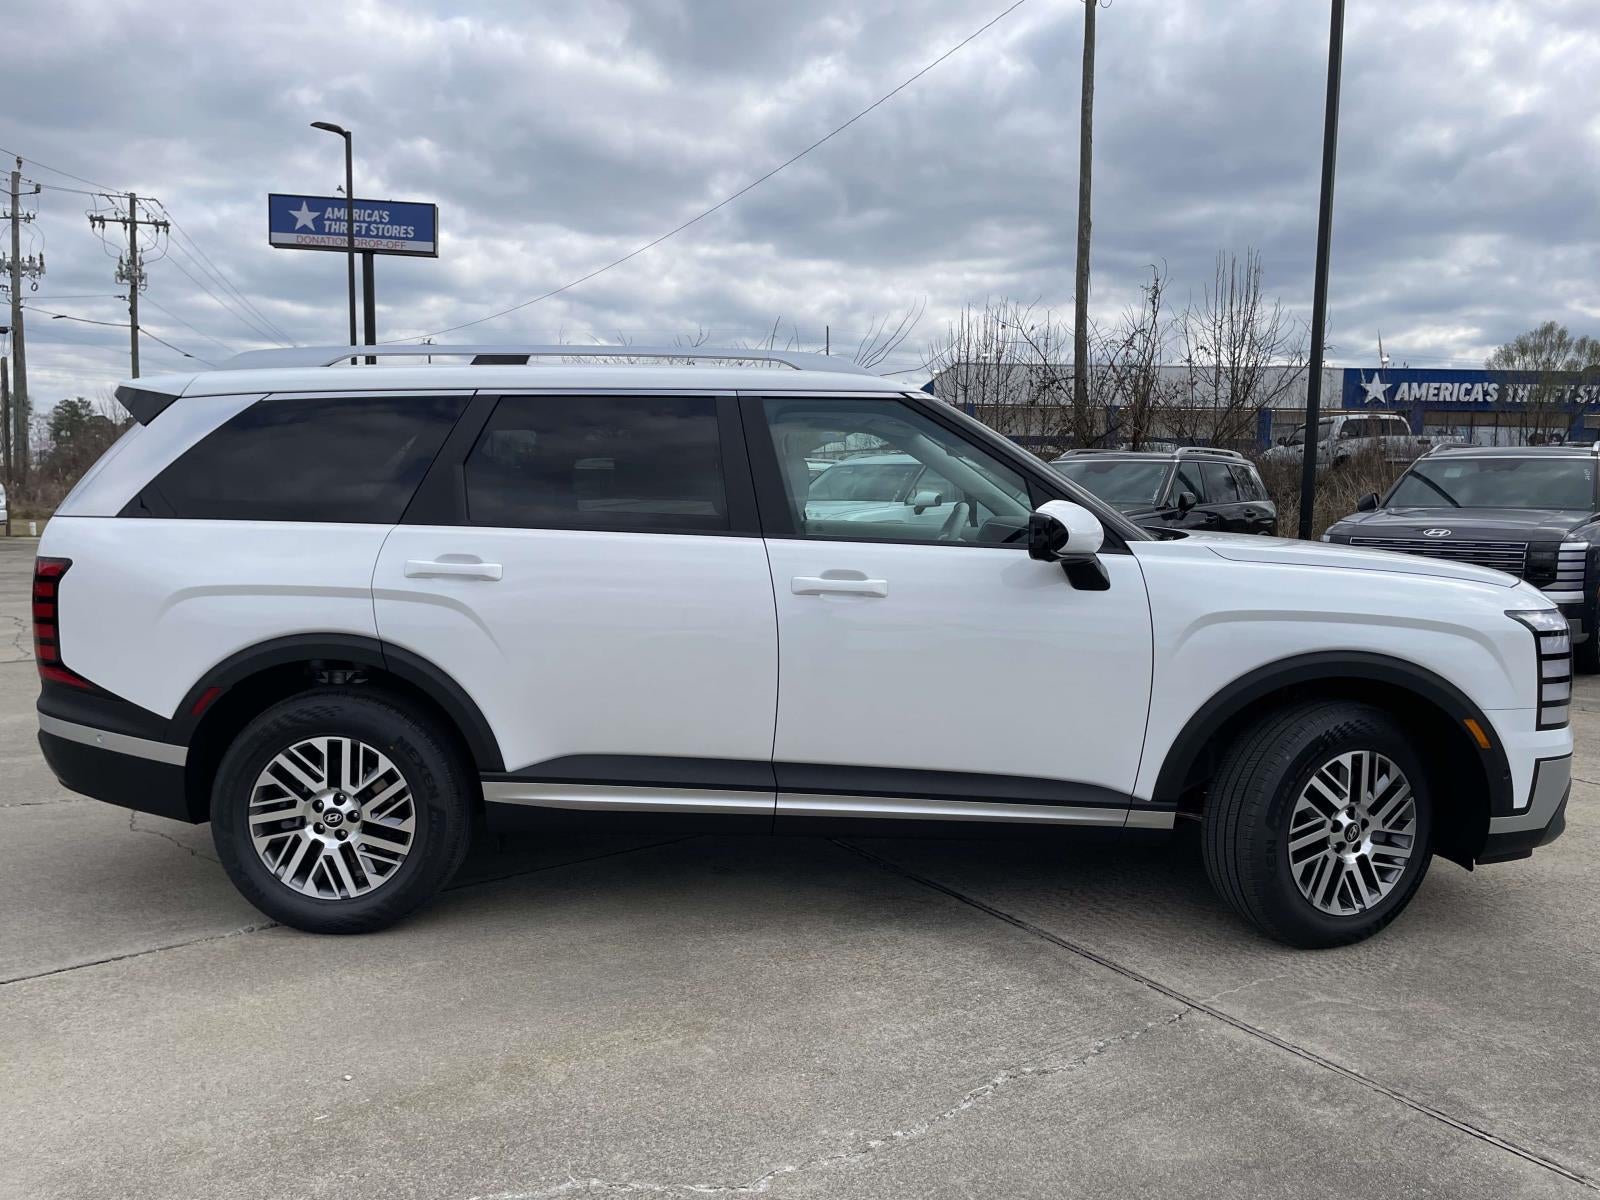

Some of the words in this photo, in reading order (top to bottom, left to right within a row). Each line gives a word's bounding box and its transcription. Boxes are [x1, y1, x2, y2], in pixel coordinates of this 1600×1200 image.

[324, 207, 390, 223] AMRICA'S
[323, 220, 368, 235] THRFT
[370, 223, 415, 238] STORES
[296, 234, 349, 247] DONATION
[353, 237, 407, 250] DROP-OFF
[1394, 381, 1500, 402] AMERICA'S
[395, 735, 440, 799] NEXEN
